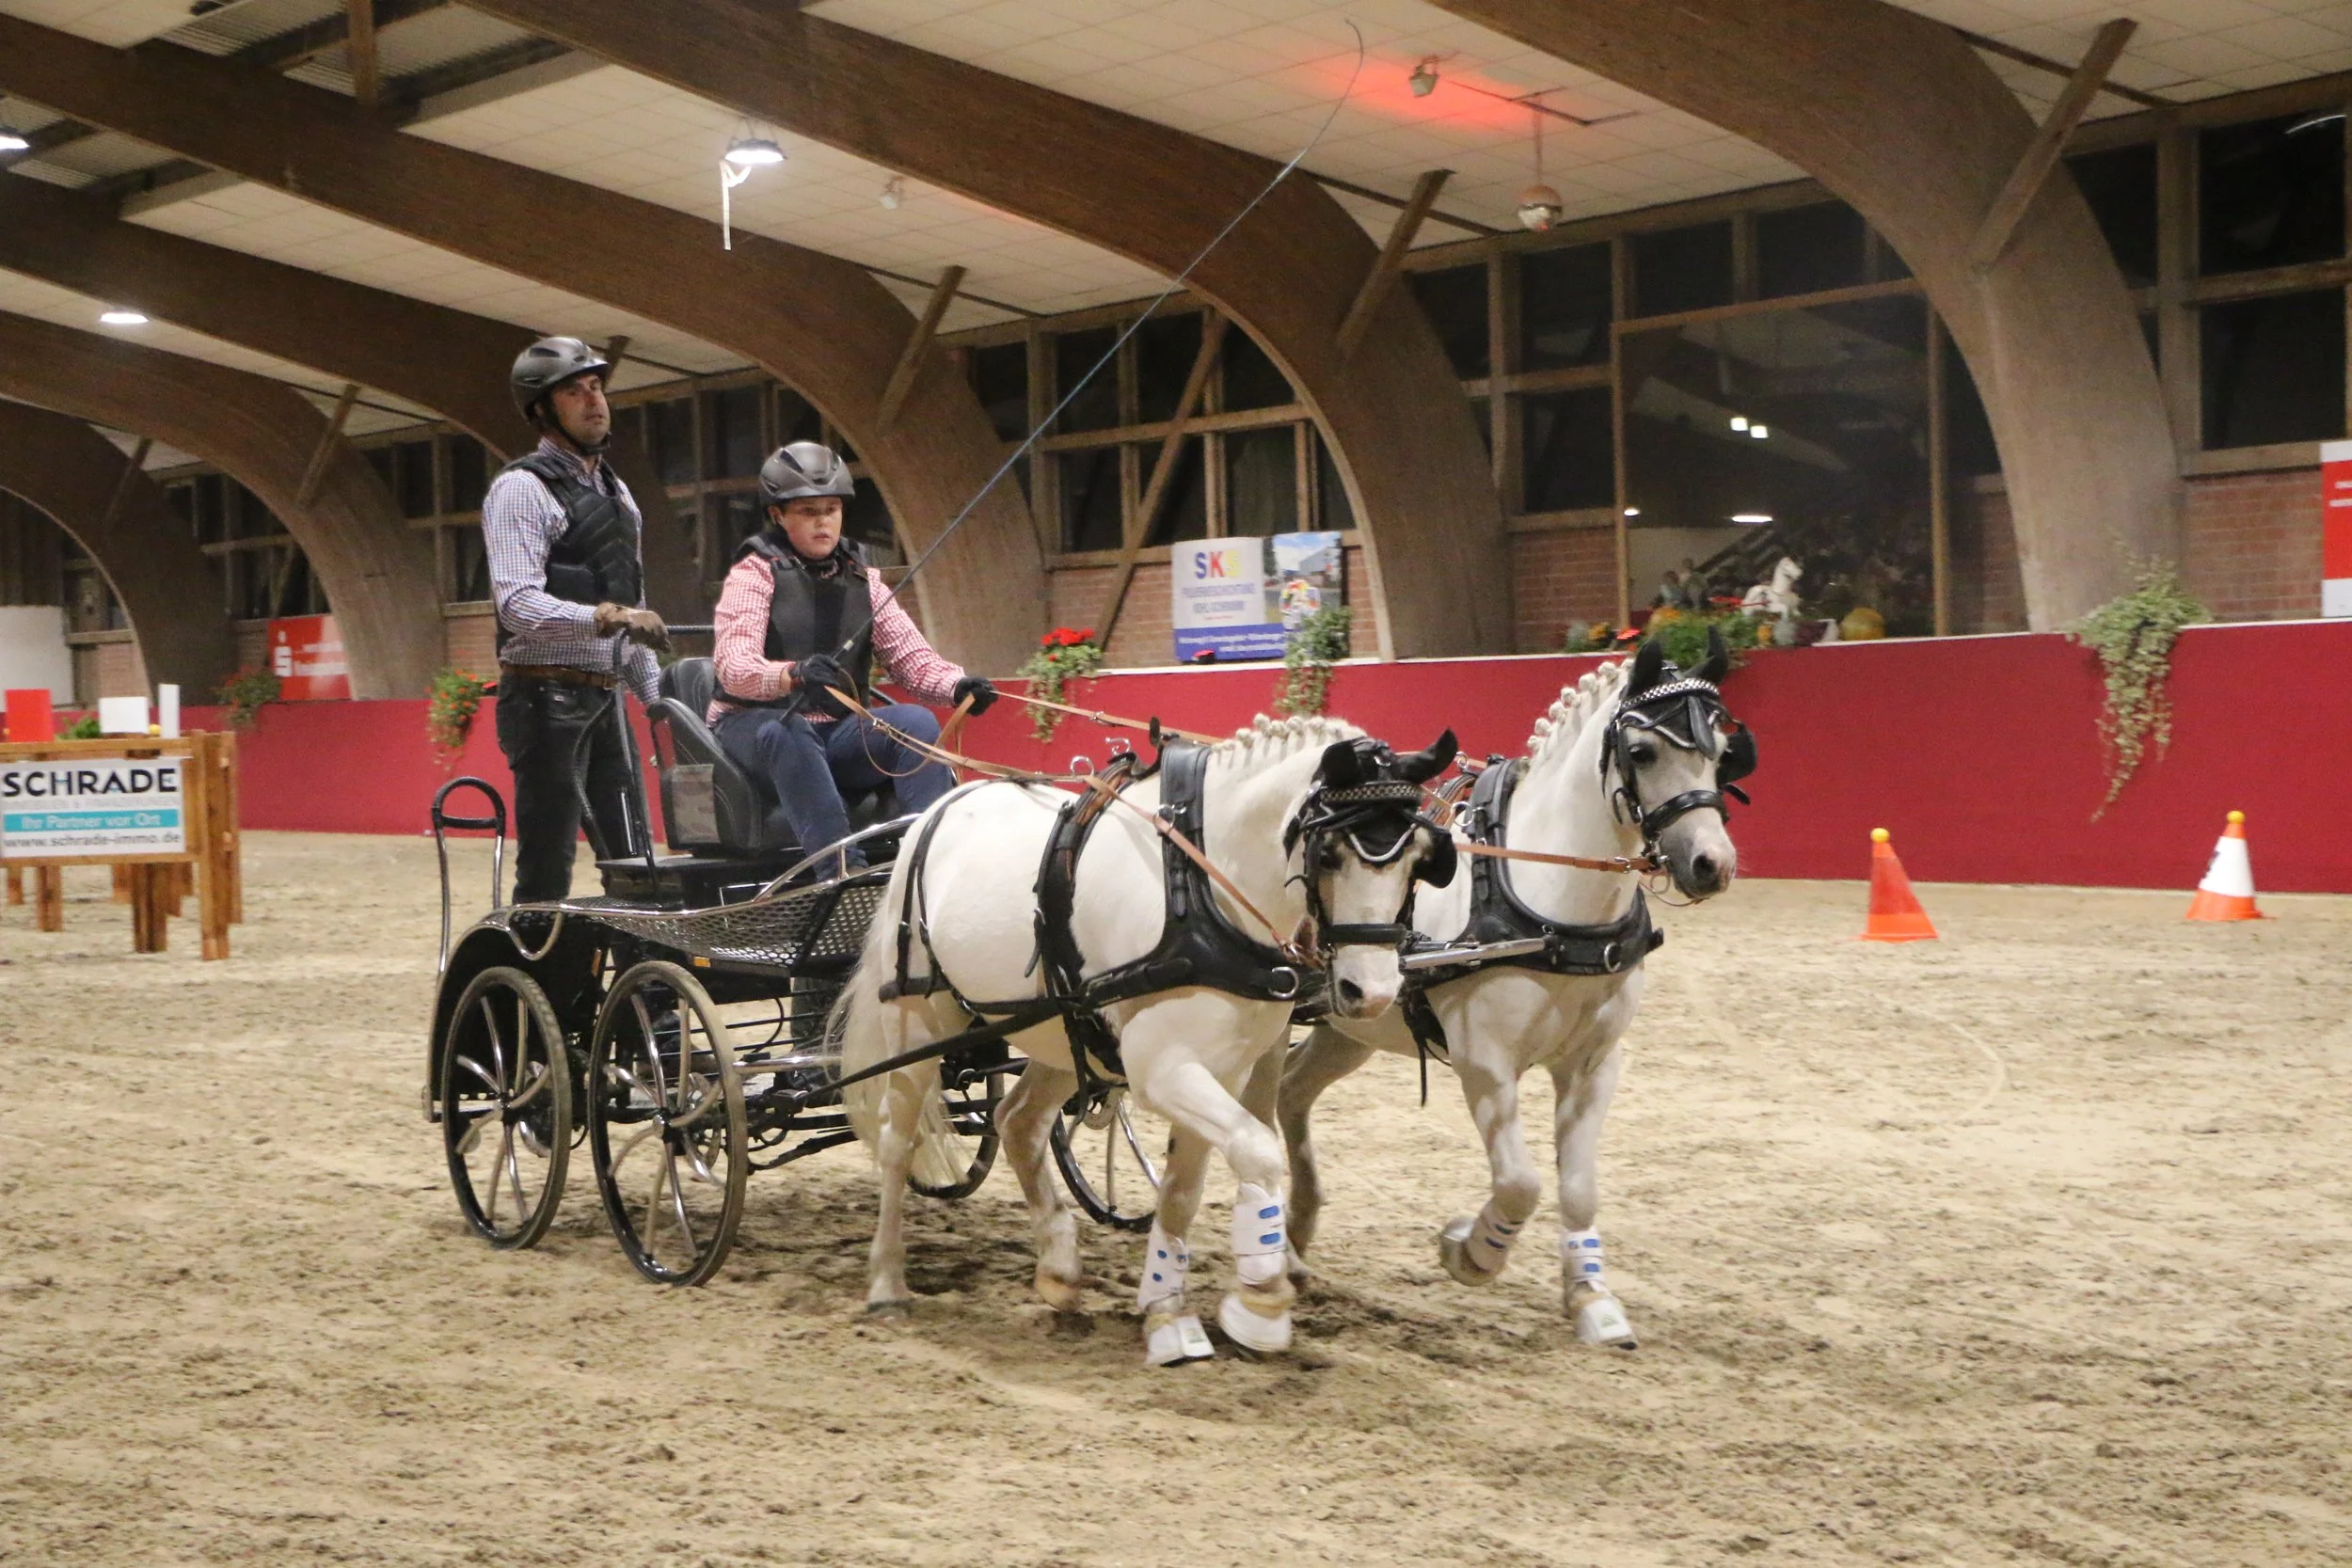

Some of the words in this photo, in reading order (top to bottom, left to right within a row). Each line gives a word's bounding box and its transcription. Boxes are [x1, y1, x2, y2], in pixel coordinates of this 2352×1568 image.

[1195, 549, 1240, 579] SKS
[3, 768, 177, 798] SCHRADE
[22, 816, 42, 829] Ihr
[47, 816, 102, 828] Partner
[106, 817, 132, 828] vor
[135, 813, 160, 826] Ort
